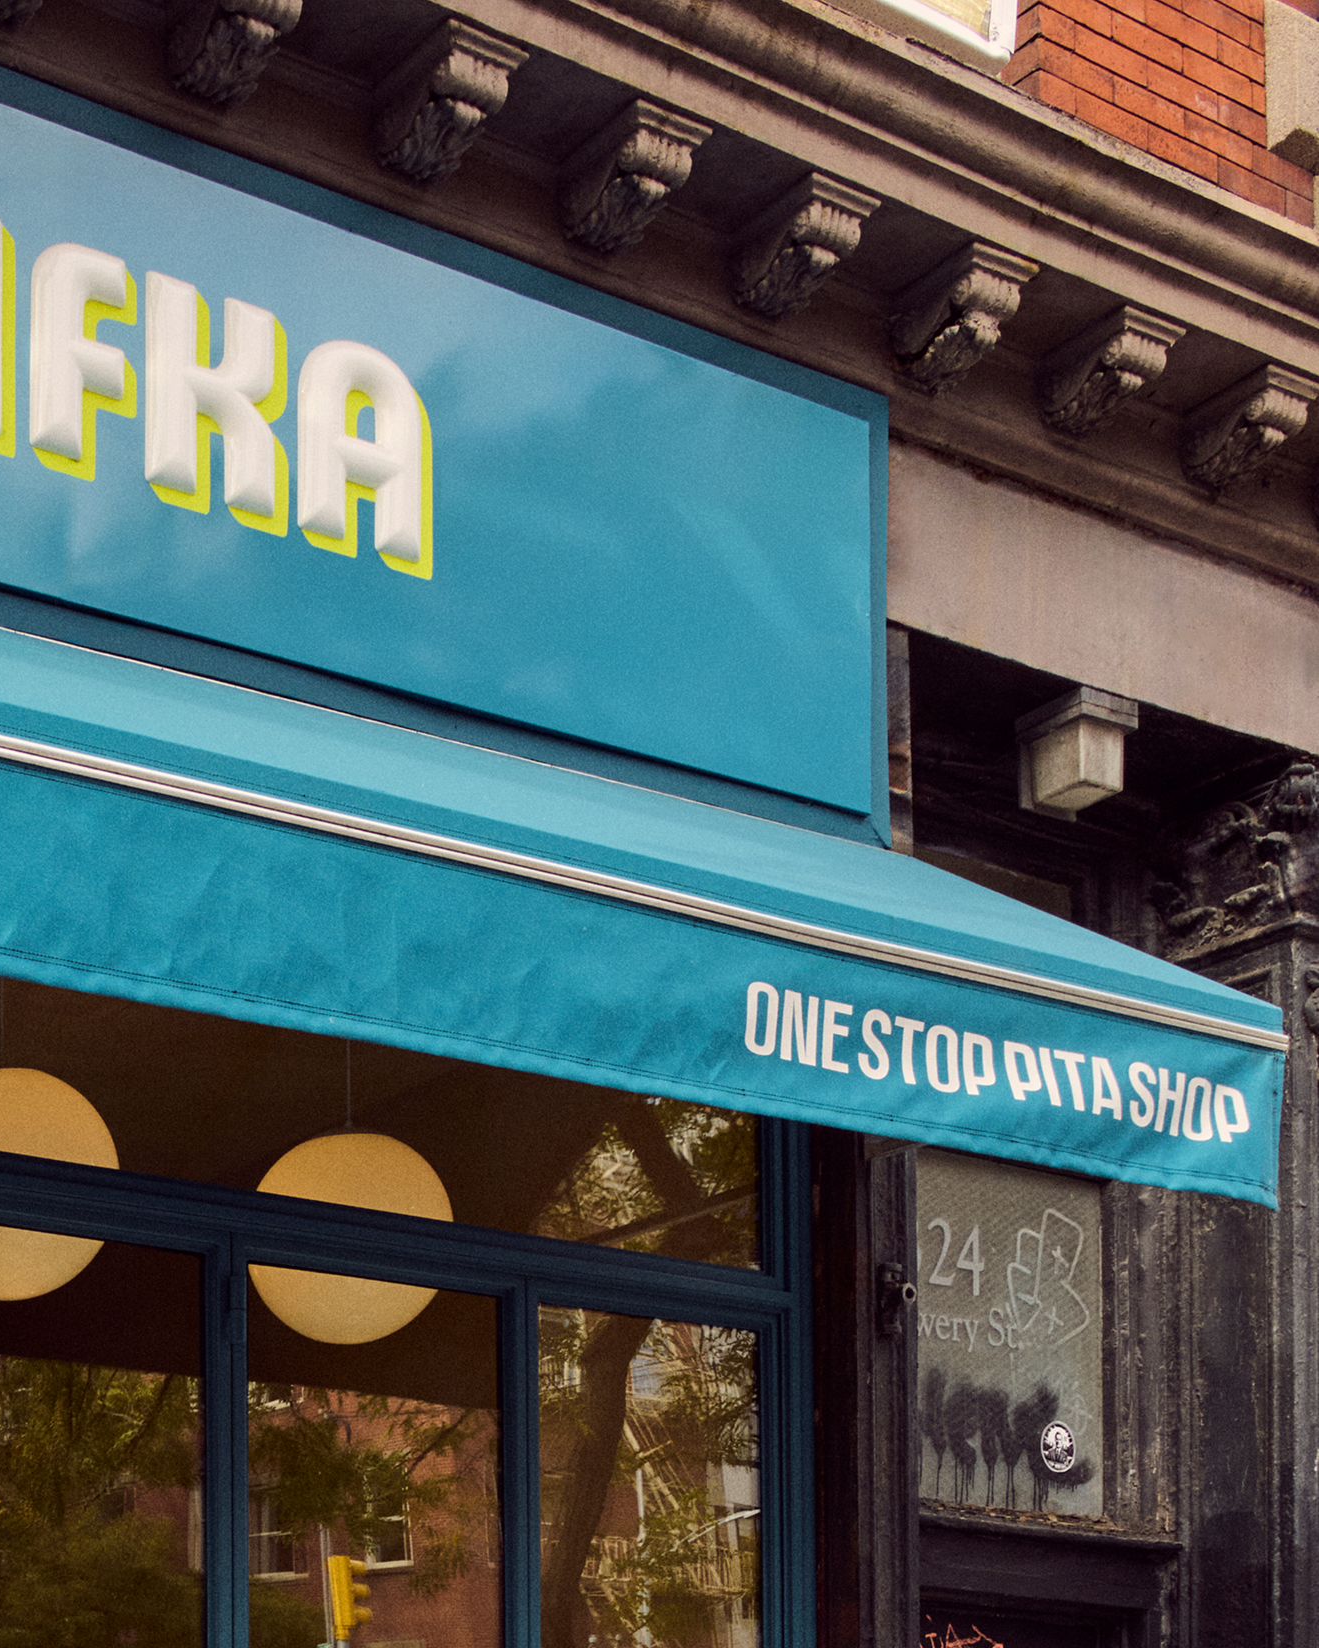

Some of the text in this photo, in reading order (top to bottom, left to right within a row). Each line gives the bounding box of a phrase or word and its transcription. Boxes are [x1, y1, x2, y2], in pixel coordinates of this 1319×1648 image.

[745, 981, 1250, 1143] ONE STOP PITA SHOP
[917, 1217, 985, 1297] 24
